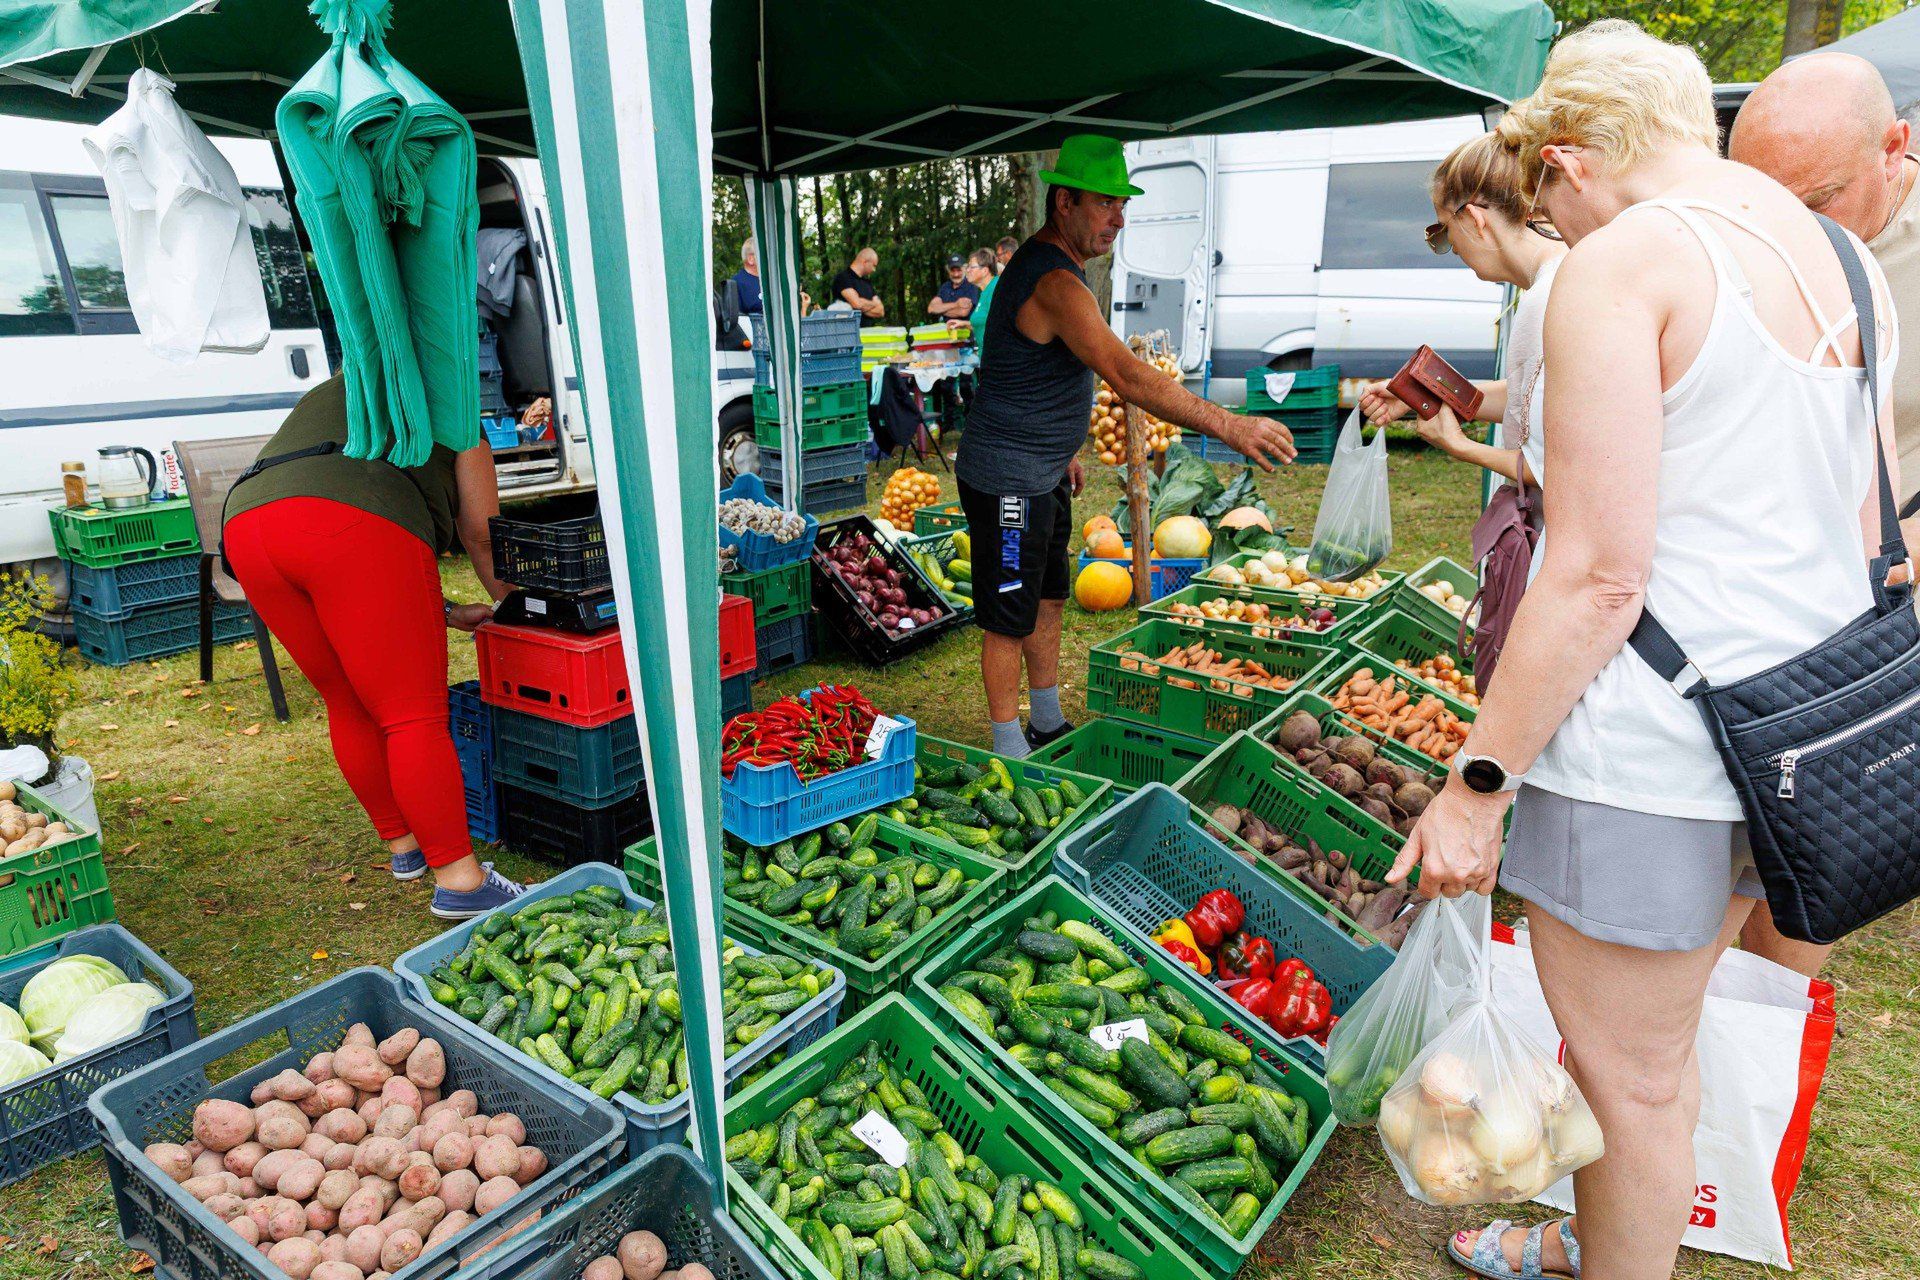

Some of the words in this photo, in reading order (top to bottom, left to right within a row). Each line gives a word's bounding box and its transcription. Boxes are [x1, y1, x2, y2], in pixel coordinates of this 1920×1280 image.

[1002, 529, 1020, 570] SPORT
[1864, 756, 1890, 776] JENNY
[1890, 743, 1916, 761] FAIRY
